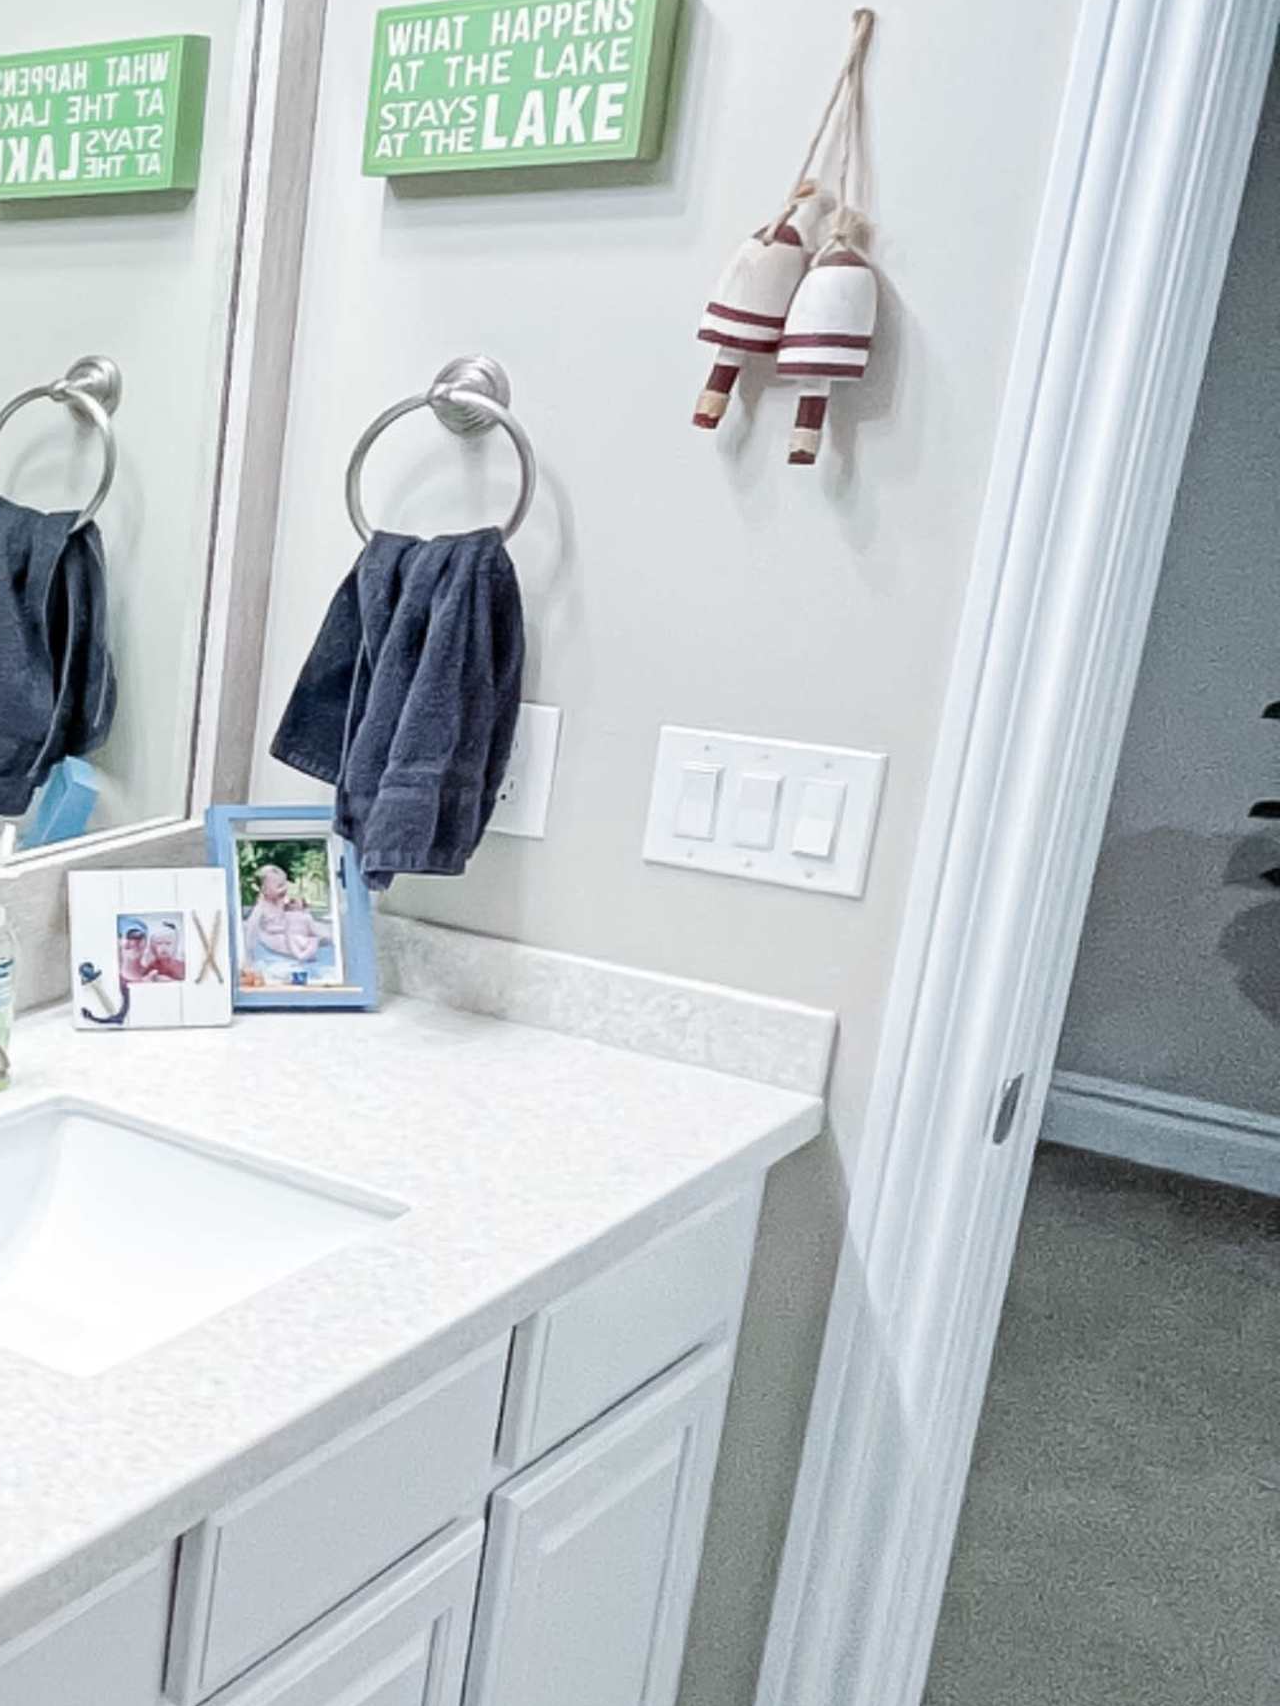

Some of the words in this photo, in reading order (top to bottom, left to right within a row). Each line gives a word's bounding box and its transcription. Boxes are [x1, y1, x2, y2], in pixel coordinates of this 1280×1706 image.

[388, 15, 469, 56] WHAT
[383, 60, 424, 94] AT
[445, 50, 513, 88] THE
[534, 37, 632, 80] LAKE
[379, 95, 477, 130] STAYS
[481, 82, 628, 150] LAKE
[375, 132, 409, 157] AT
[421, 126, 475, 155] THE
